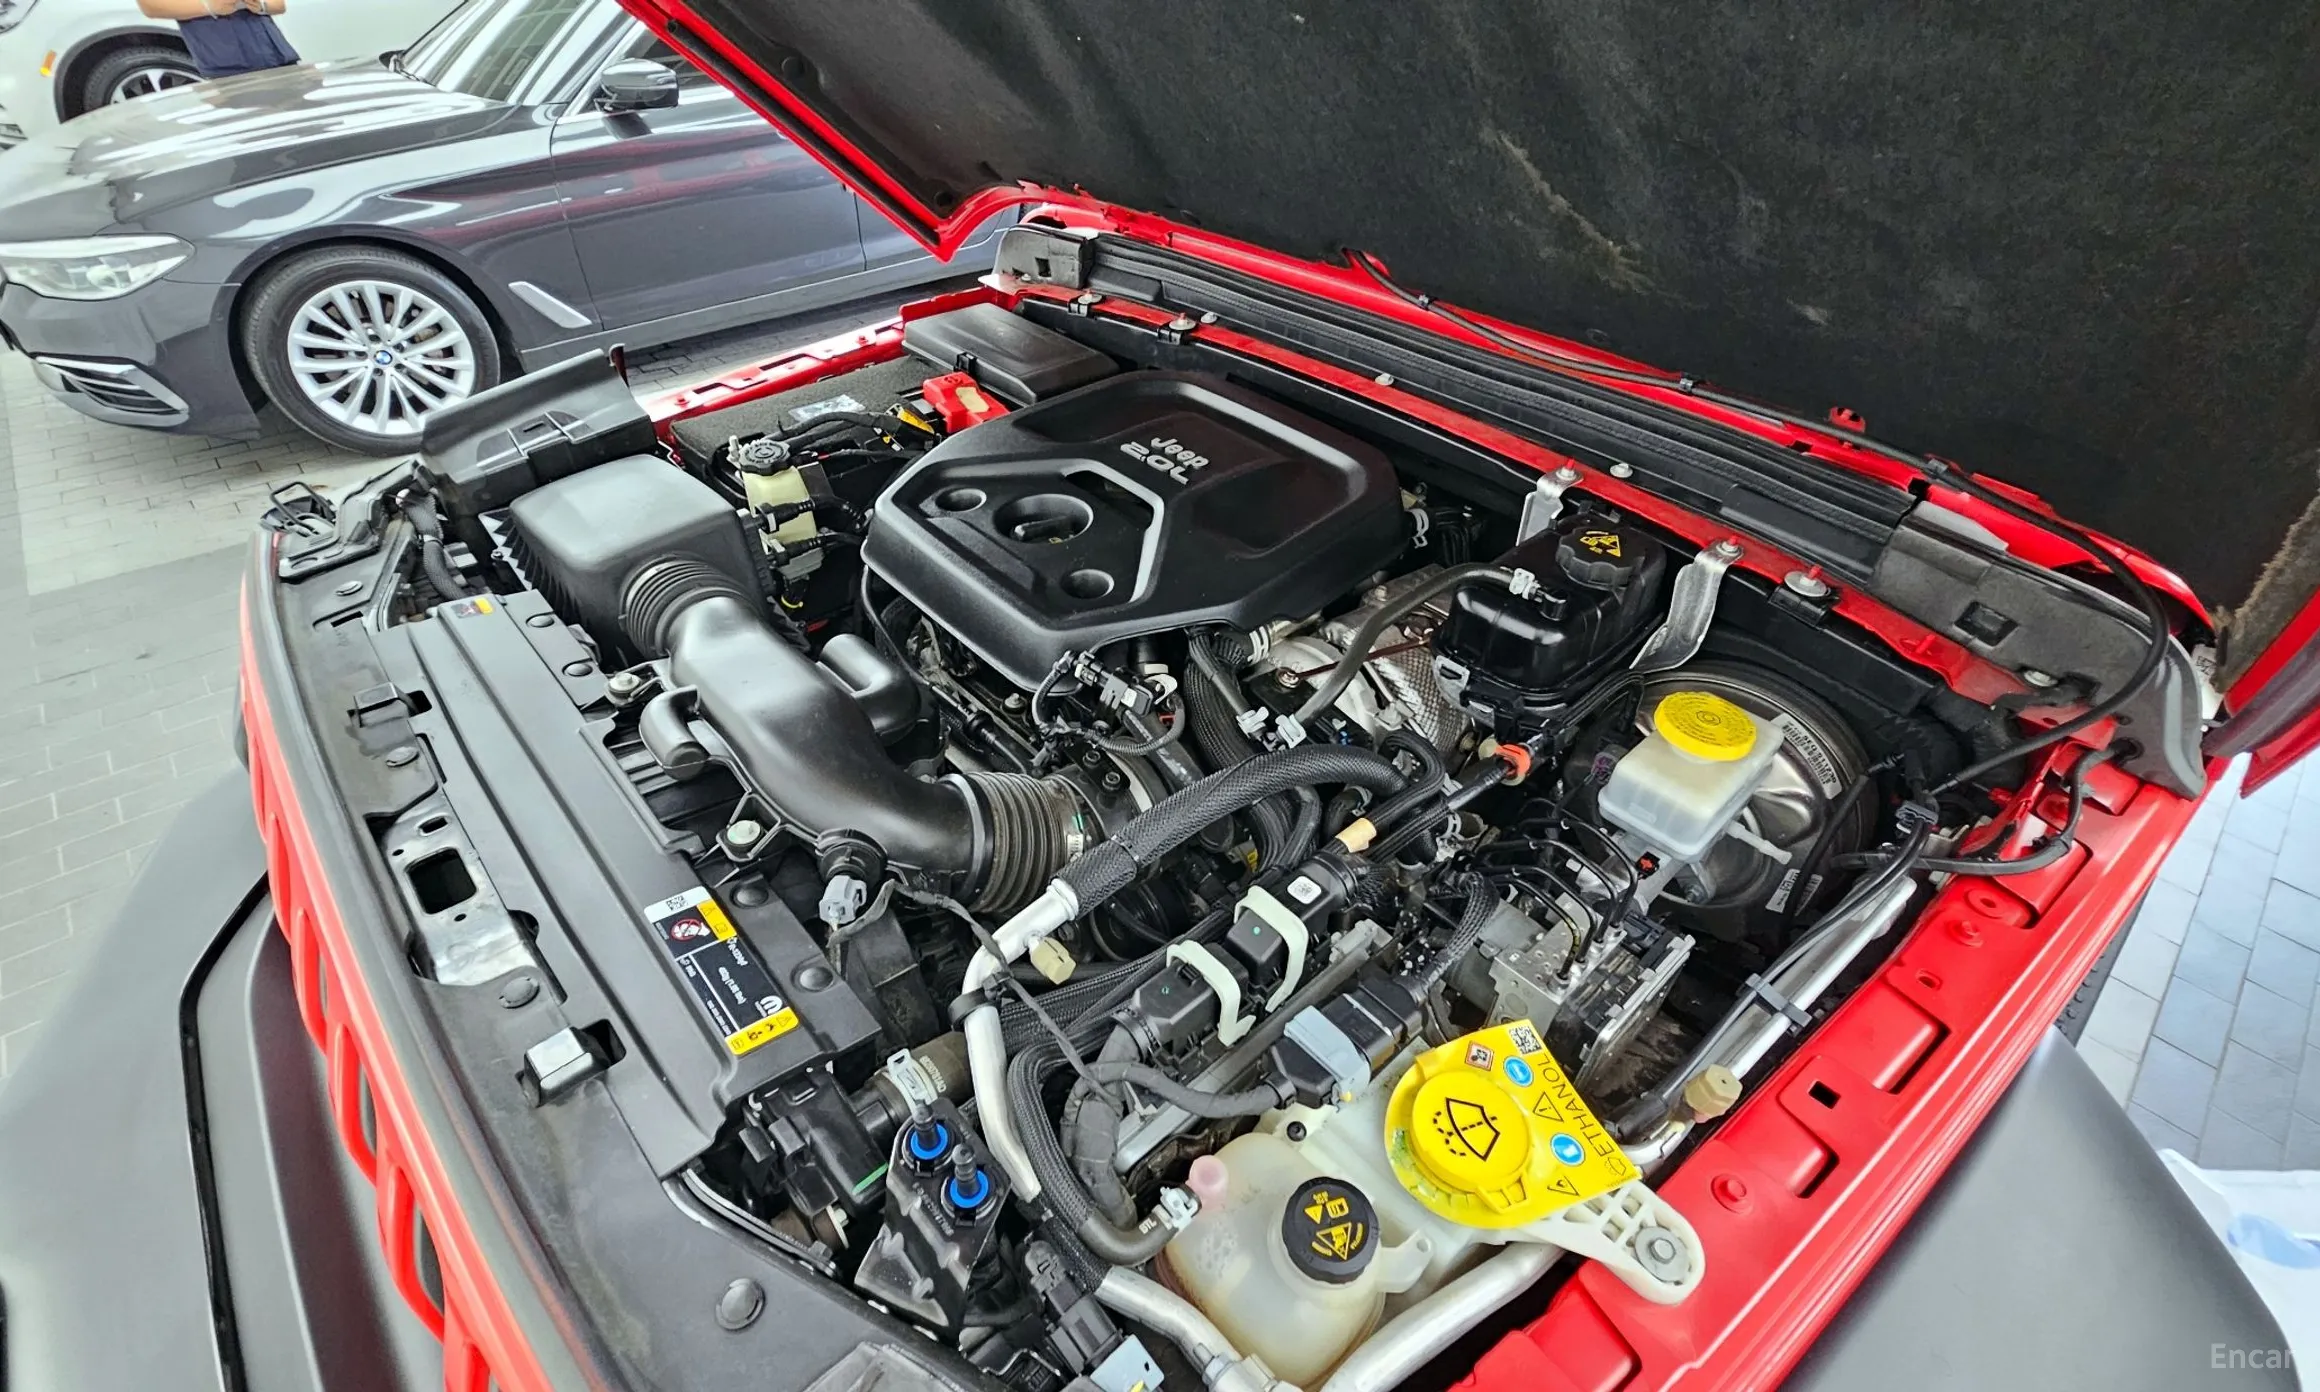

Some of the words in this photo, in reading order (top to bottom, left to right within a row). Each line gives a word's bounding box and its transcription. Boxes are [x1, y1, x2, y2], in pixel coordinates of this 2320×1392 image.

[1120, 441, 1189, 485] 2.0L
[1151, 437, 1209, 469] Jeep
[1537, 1054, 1616, 1158] ETHANOL
